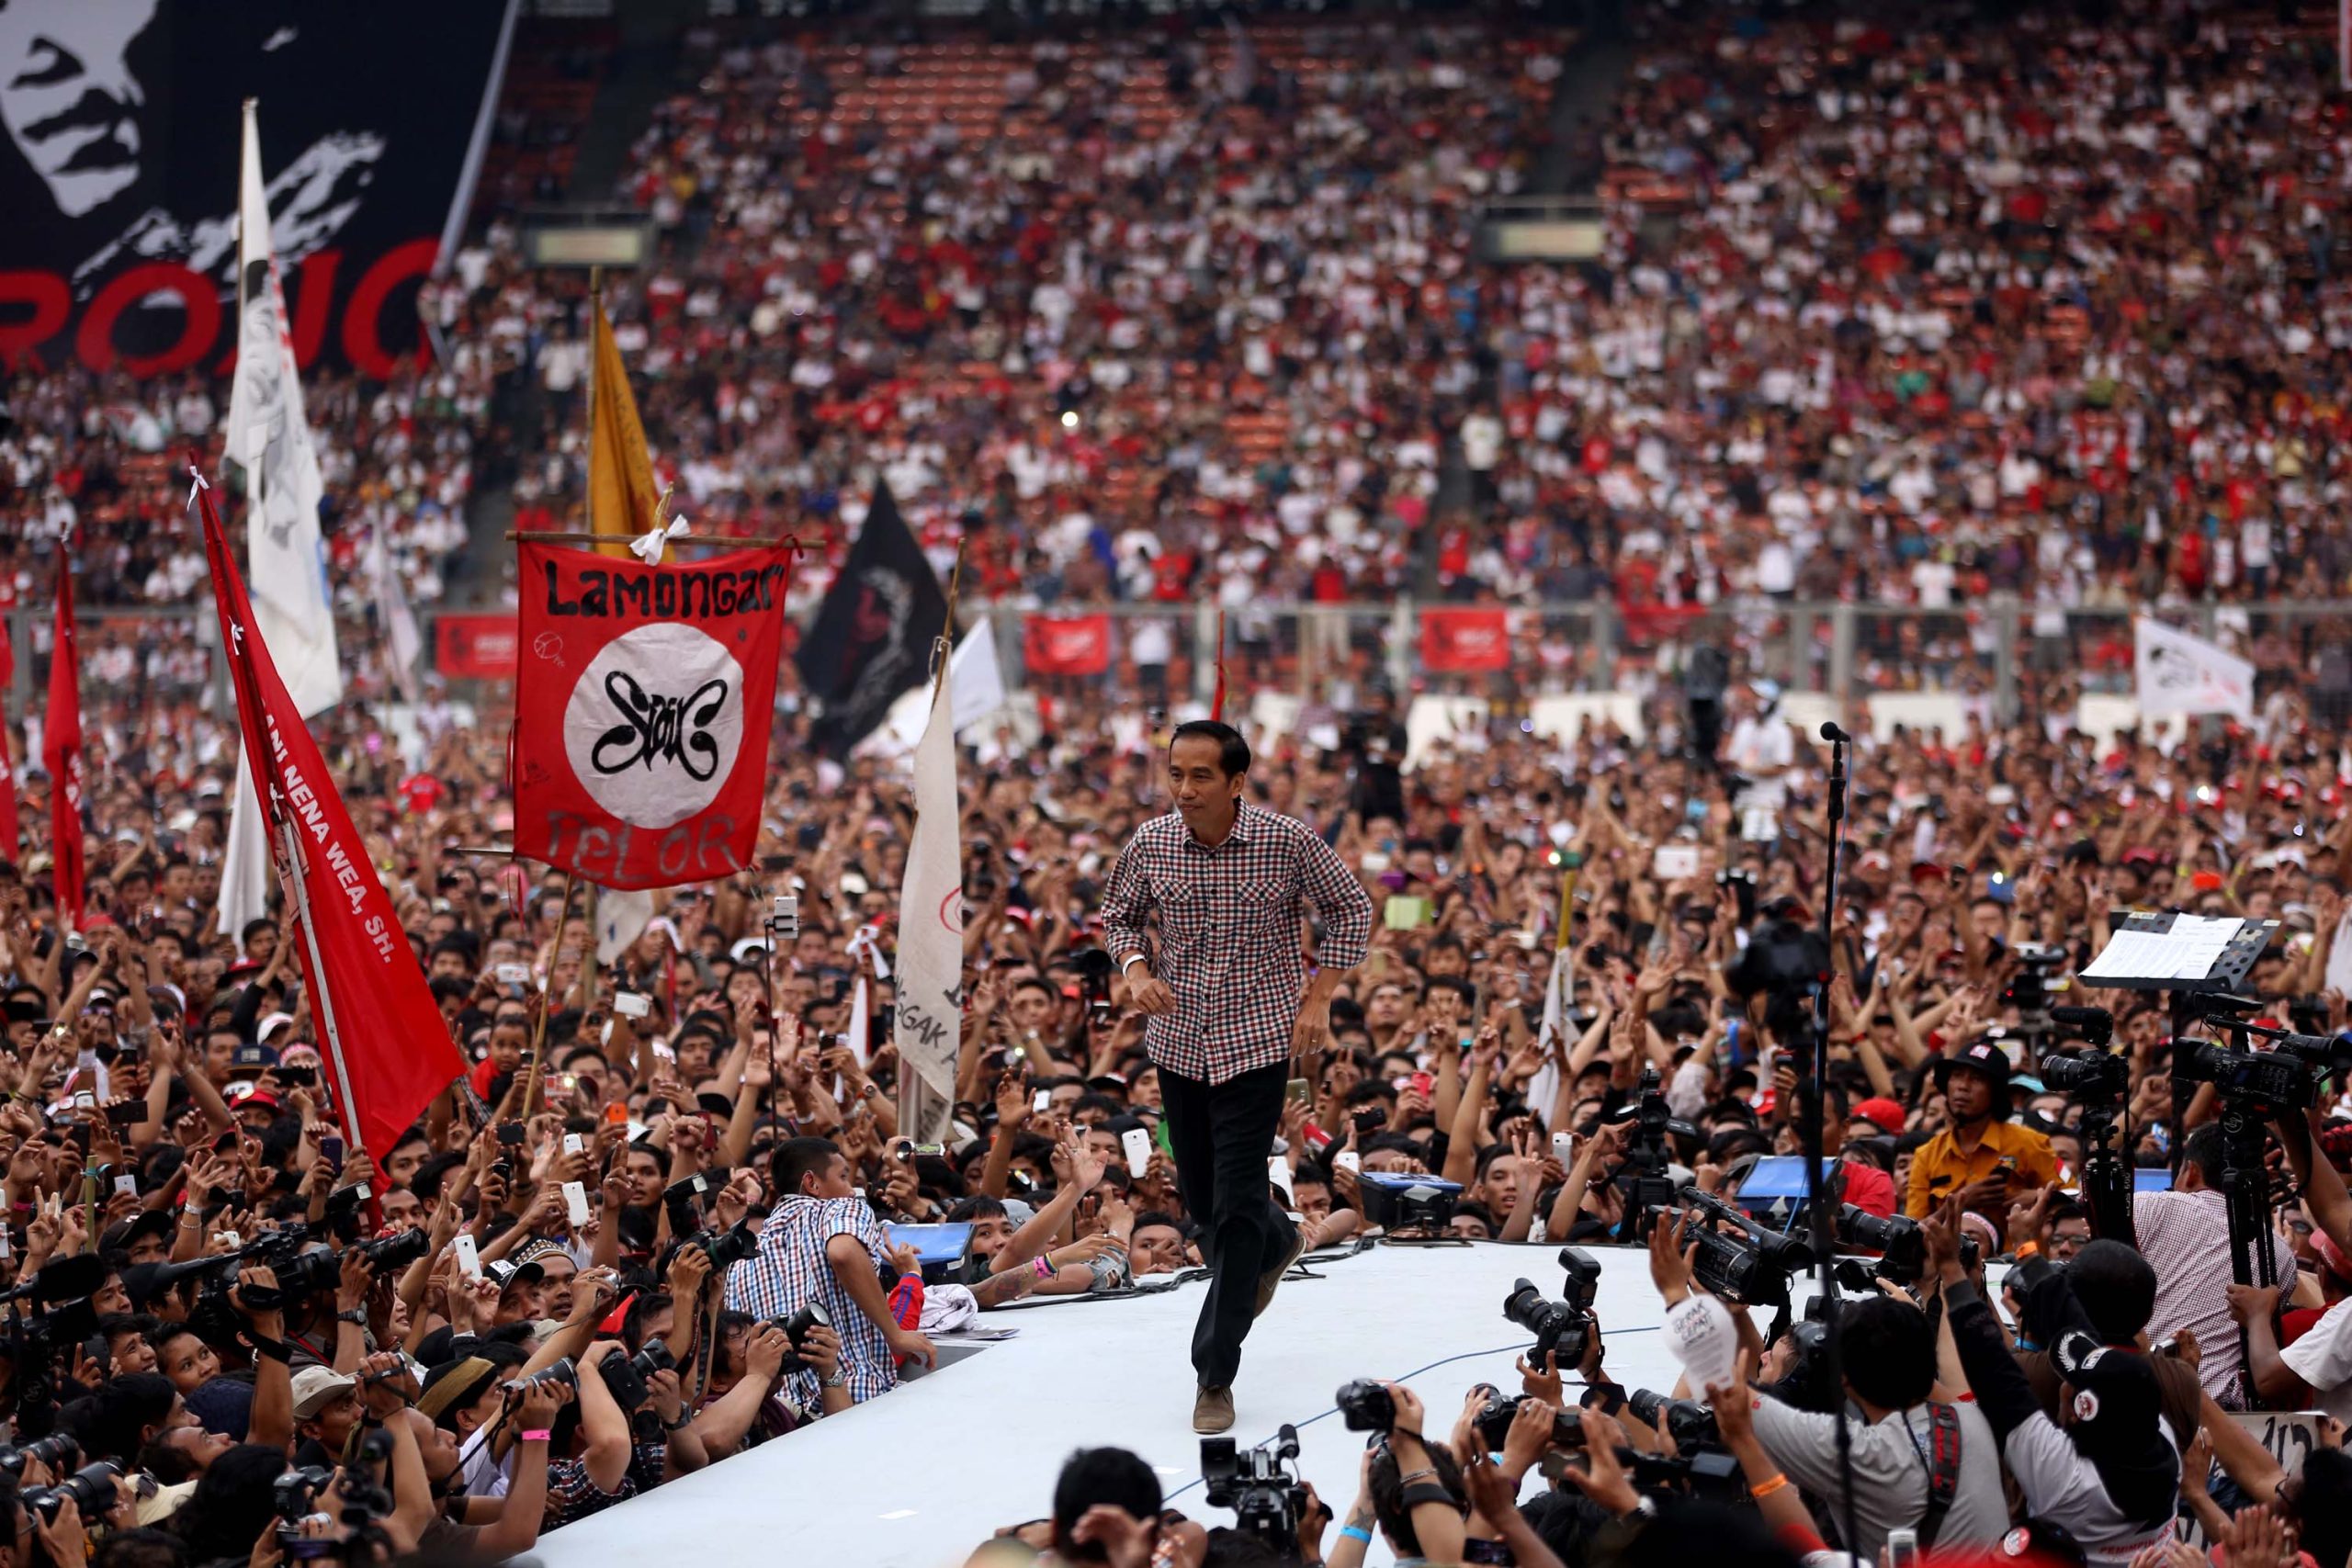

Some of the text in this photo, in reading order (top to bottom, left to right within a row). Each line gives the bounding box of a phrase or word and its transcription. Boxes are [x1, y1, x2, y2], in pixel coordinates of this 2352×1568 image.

[283, 764, 330, 844] NENA
[325, 841, 368, 915] WEA,
[365, 915, 395, 964] SH.
